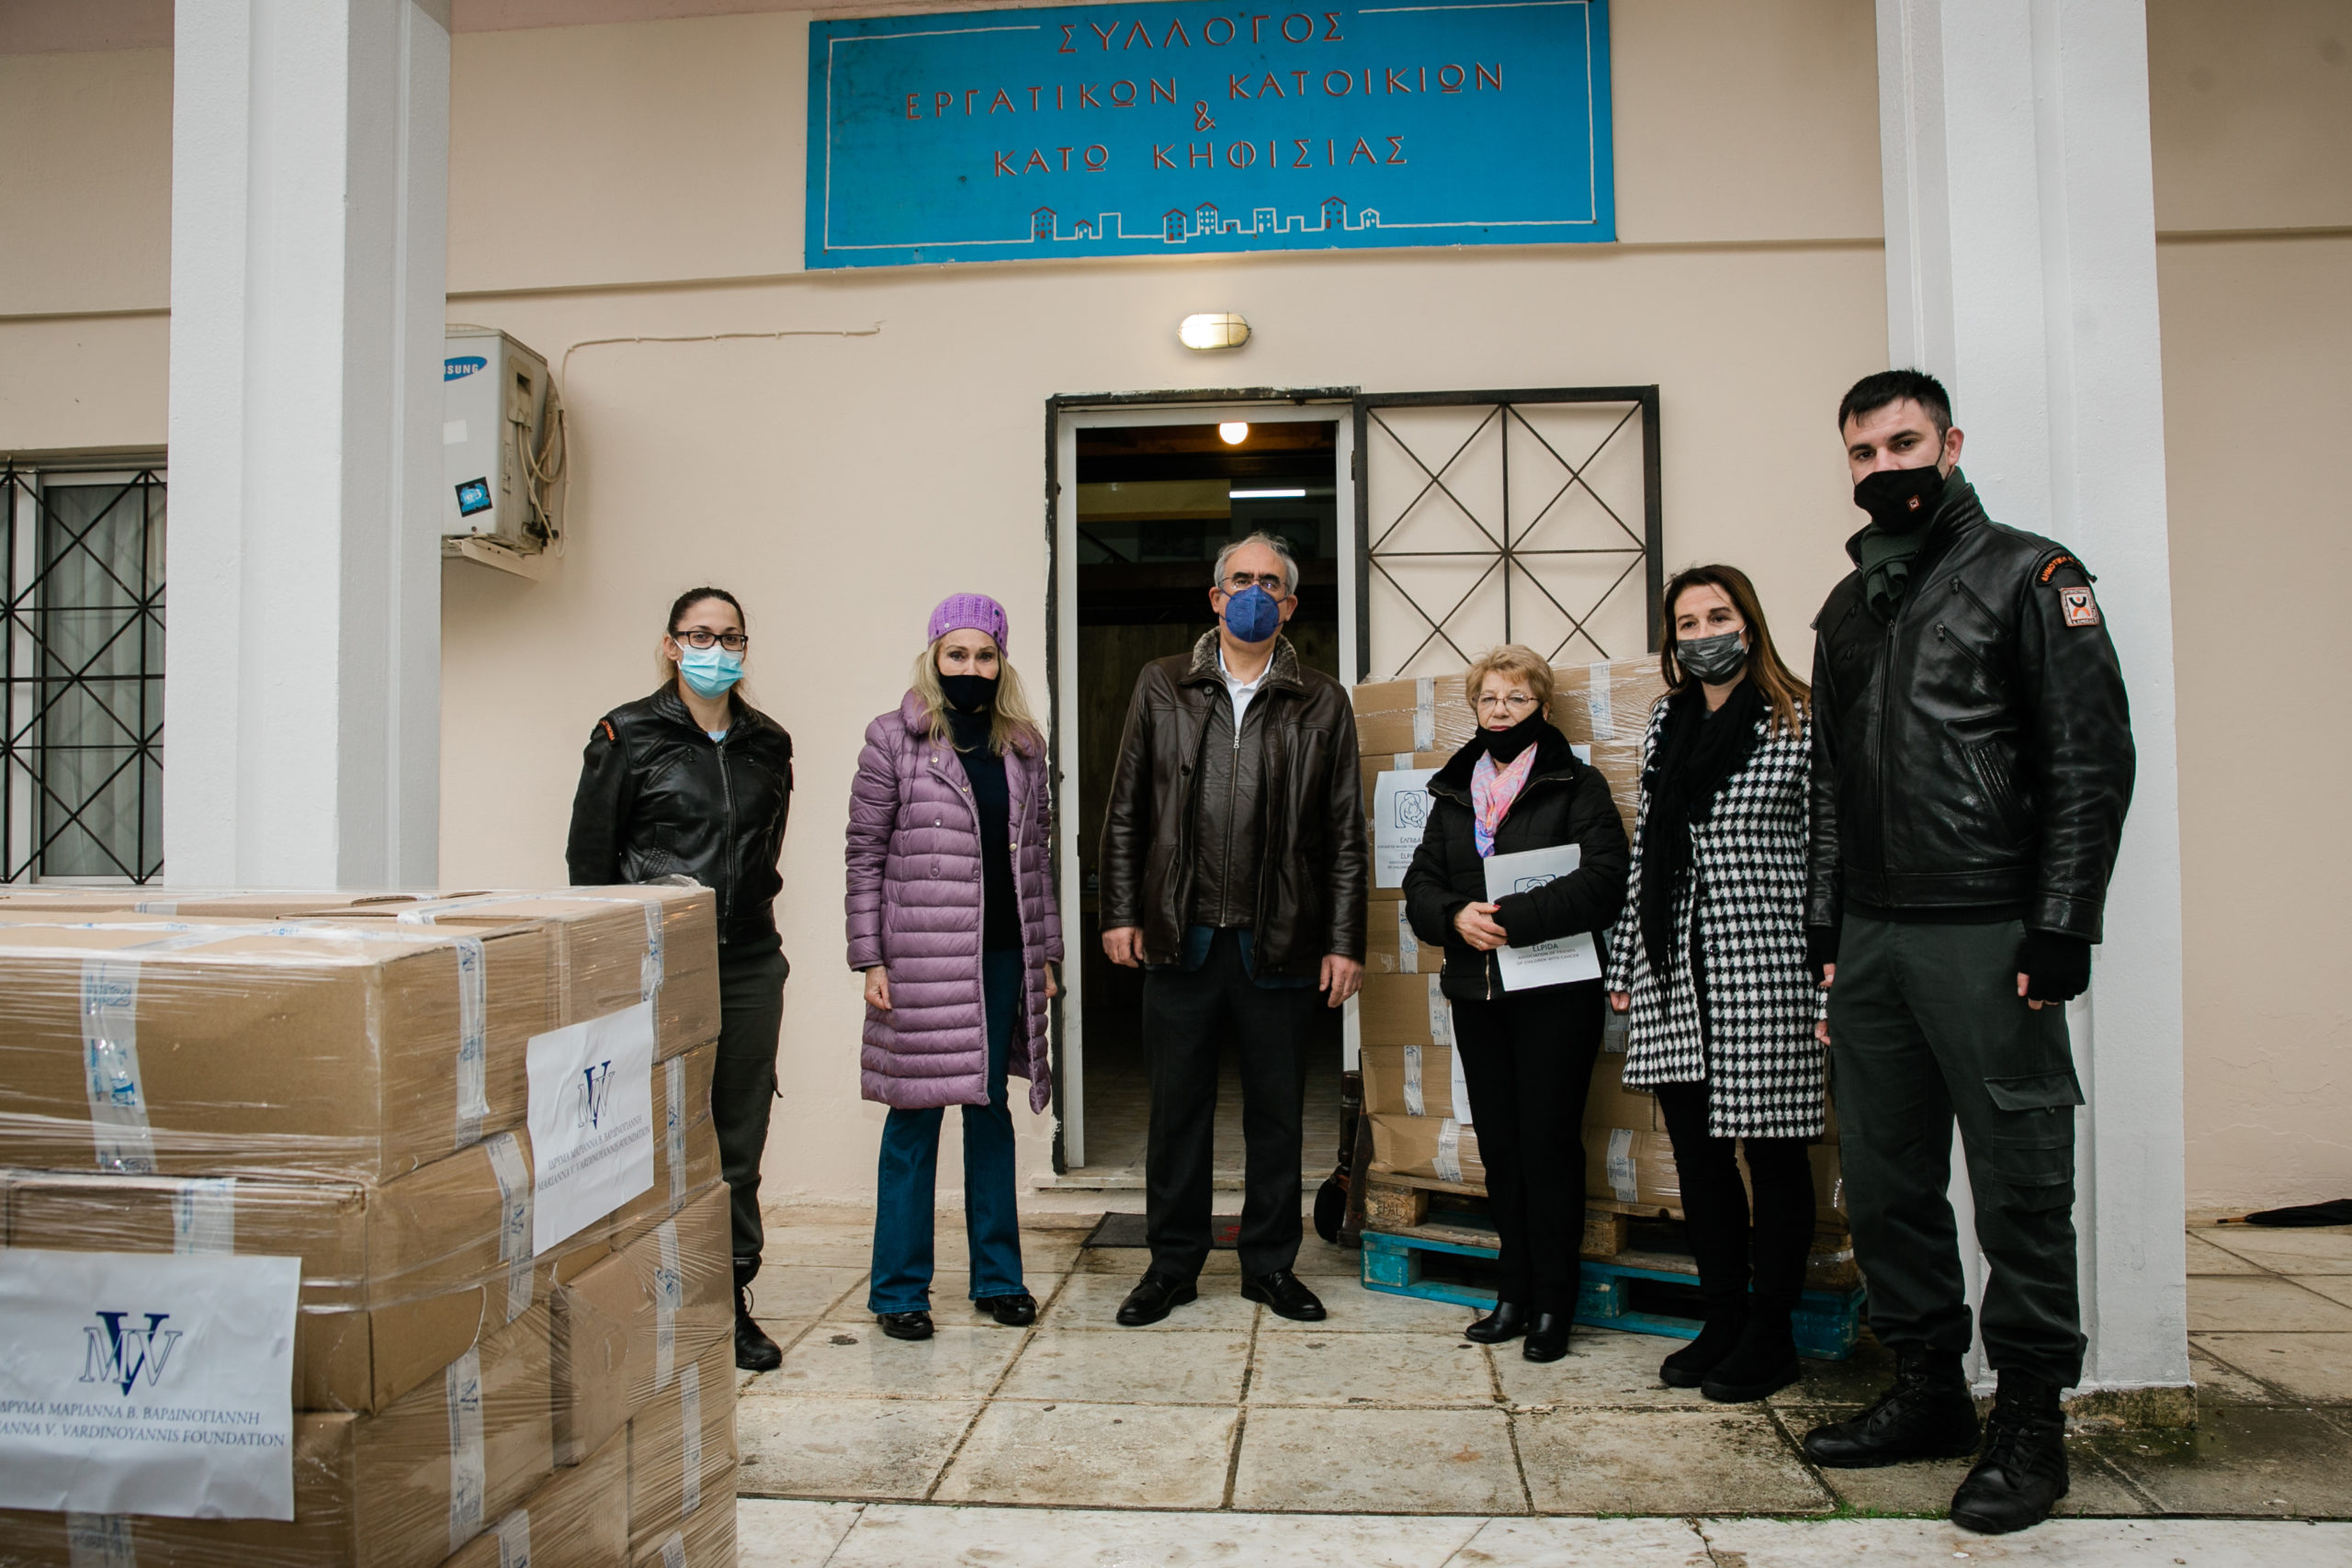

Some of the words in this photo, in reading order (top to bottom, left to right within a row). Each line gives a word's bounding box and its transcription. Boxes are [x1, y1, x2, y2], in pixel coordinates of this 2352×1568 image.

[1058, 12, 1344, 53] ΣΥΛΛΟΓΟΣ
[906, 77, 1177, 120] ΕΡΓΑΤΙΚΩΝ
[1228, 62, 1502, 100] ΚΑΤΟΙΚΙΩΝ
[1194, 100, 1216, 132] &
[994, 144, 1109, 177] ΚΑΤΩ
[1154, 135, 1408, 170] ΚΗΦΙΣΙΑΣ
[444, 364, 479, 375] SUNG
[1532, 942, 1559, 952] ELPIDA
[48, 1403, 122, 1418] ΜΑΡΙΑΝΝΑ
[142, 1406, 260, 1425] ΒΑΡΔΙΝΟΓΙΑΝΝΗ
[62, 1424, 179, 1442] VARDINOYANNIS
[183, 1429, 285, 1447] FOUNDATION
